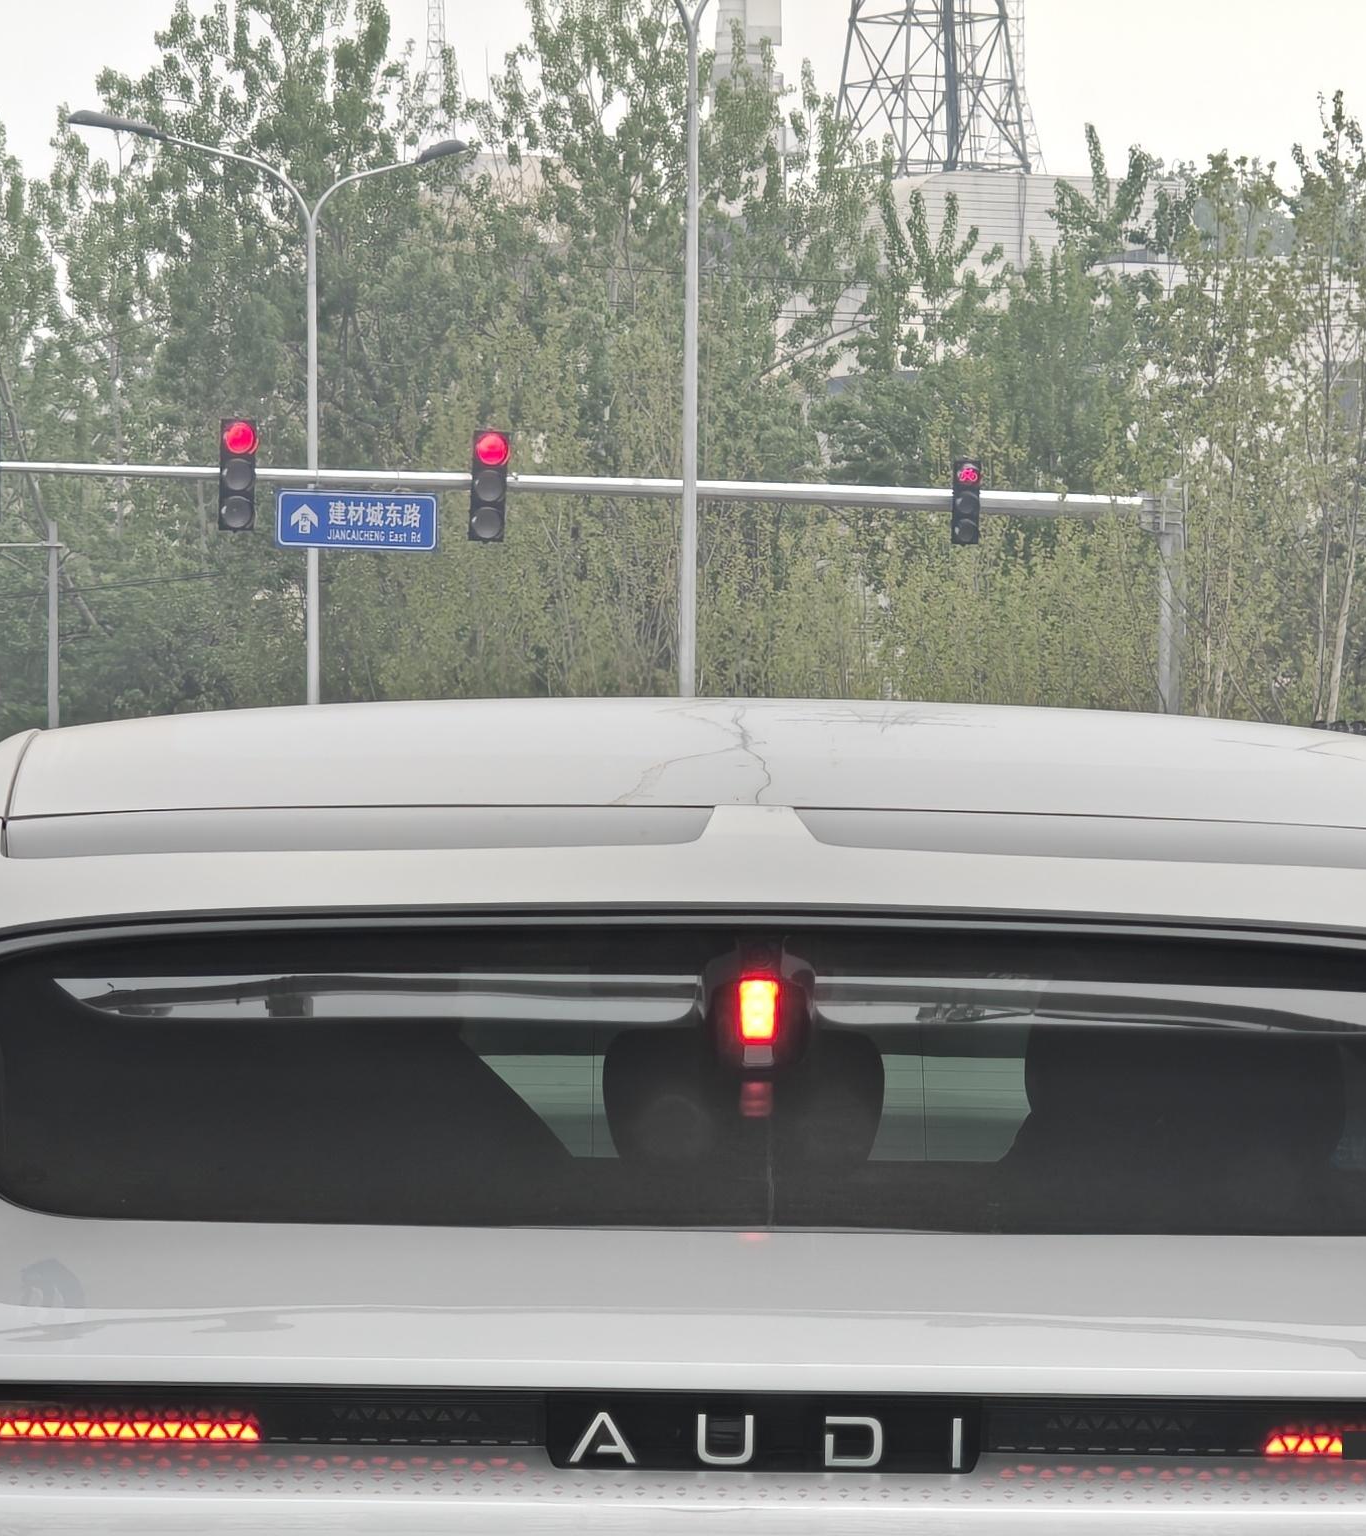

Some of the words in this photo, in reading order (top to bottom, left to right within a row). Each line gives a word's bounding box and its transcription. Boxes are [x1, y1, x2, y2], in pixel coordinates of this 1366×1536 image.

[328, 501, 421, 528] 建材城东路
[327, 529, 385, 542] JIANCAICHENG
[389, 531, 407, 543] East
[411, 532, 421, 543] Rd
[568, 1411, 963, 1469] AUDI
